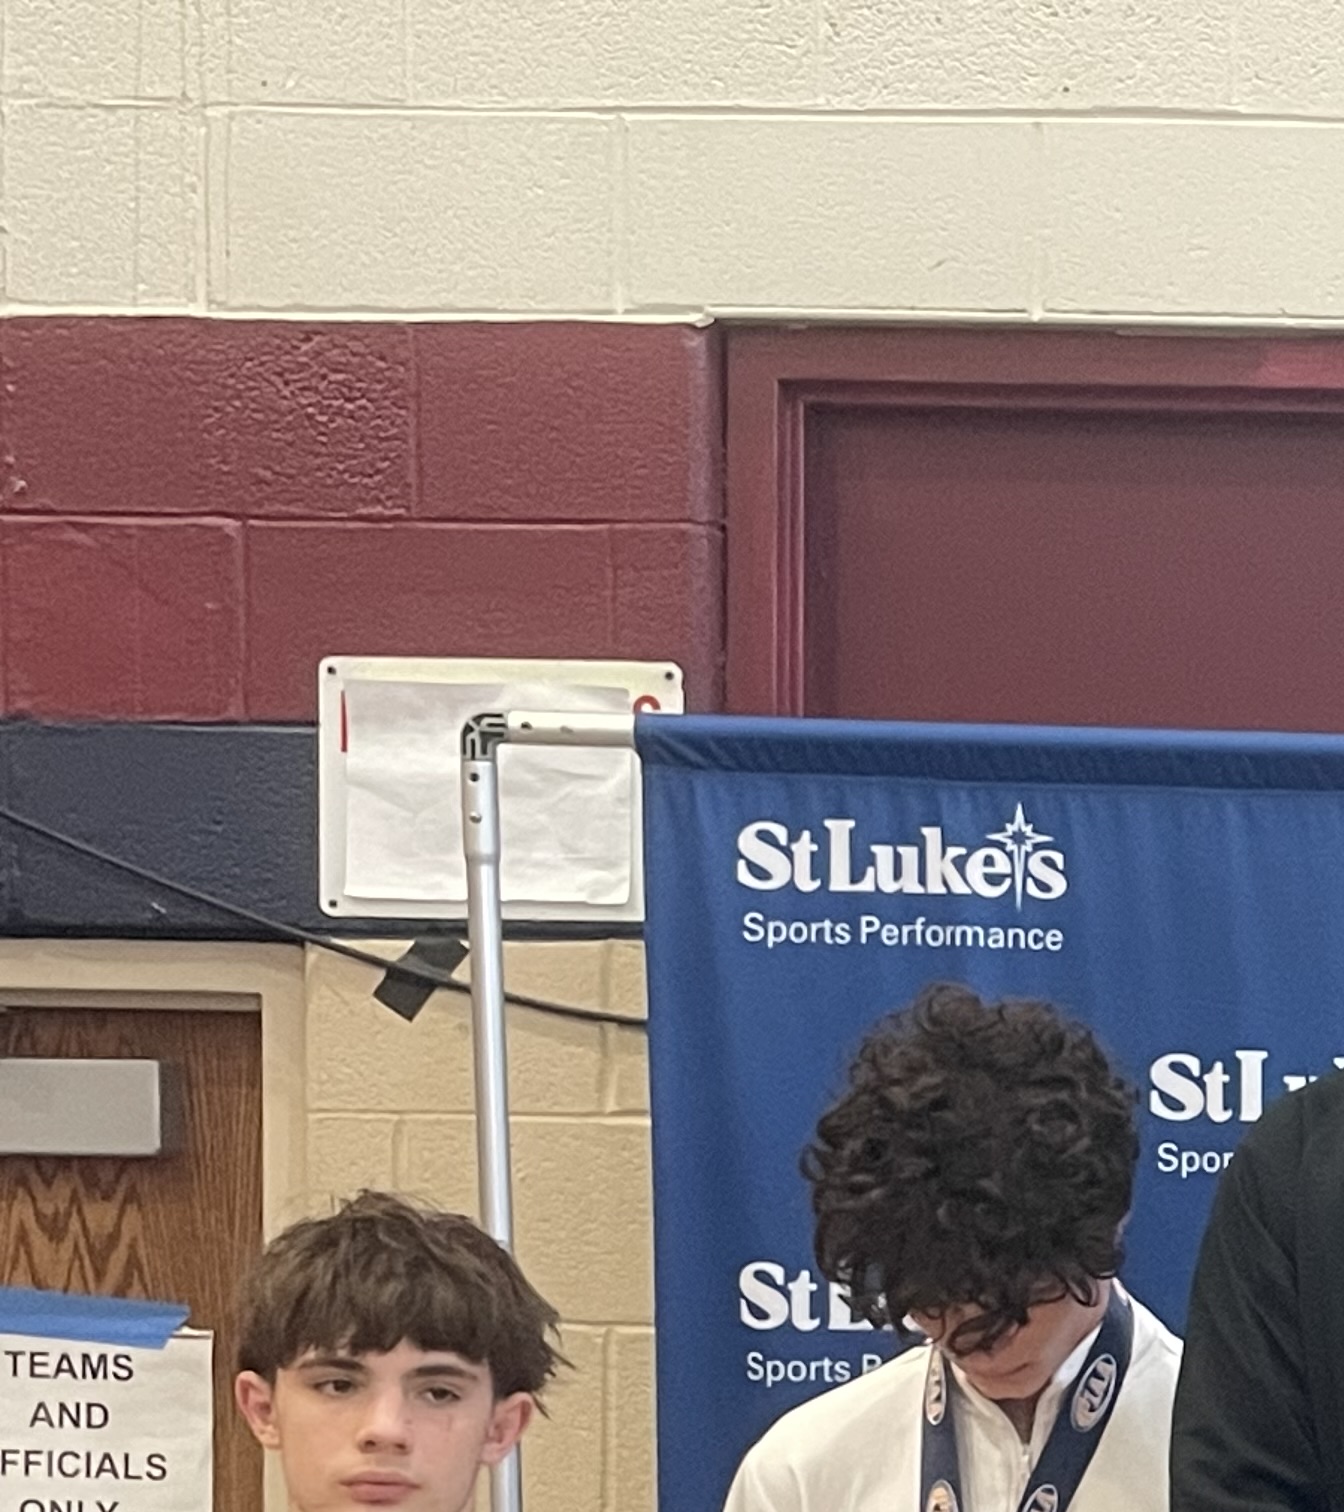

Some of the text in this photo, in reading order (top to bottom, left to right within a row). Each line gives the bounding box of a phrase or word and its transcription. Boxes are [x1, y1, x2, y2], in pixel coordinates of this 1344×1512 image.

[743, 914, 1063, 951] Sports Performance
[1158, 1144, 1233, 1177] Spor
[7, 1351, 134, 1381] TEAMS
[747, 1352, 851, 1385] Sports
[30, 1402, 109, 1429] AND
[0, 1451, 167, 1480] FFICIALS
